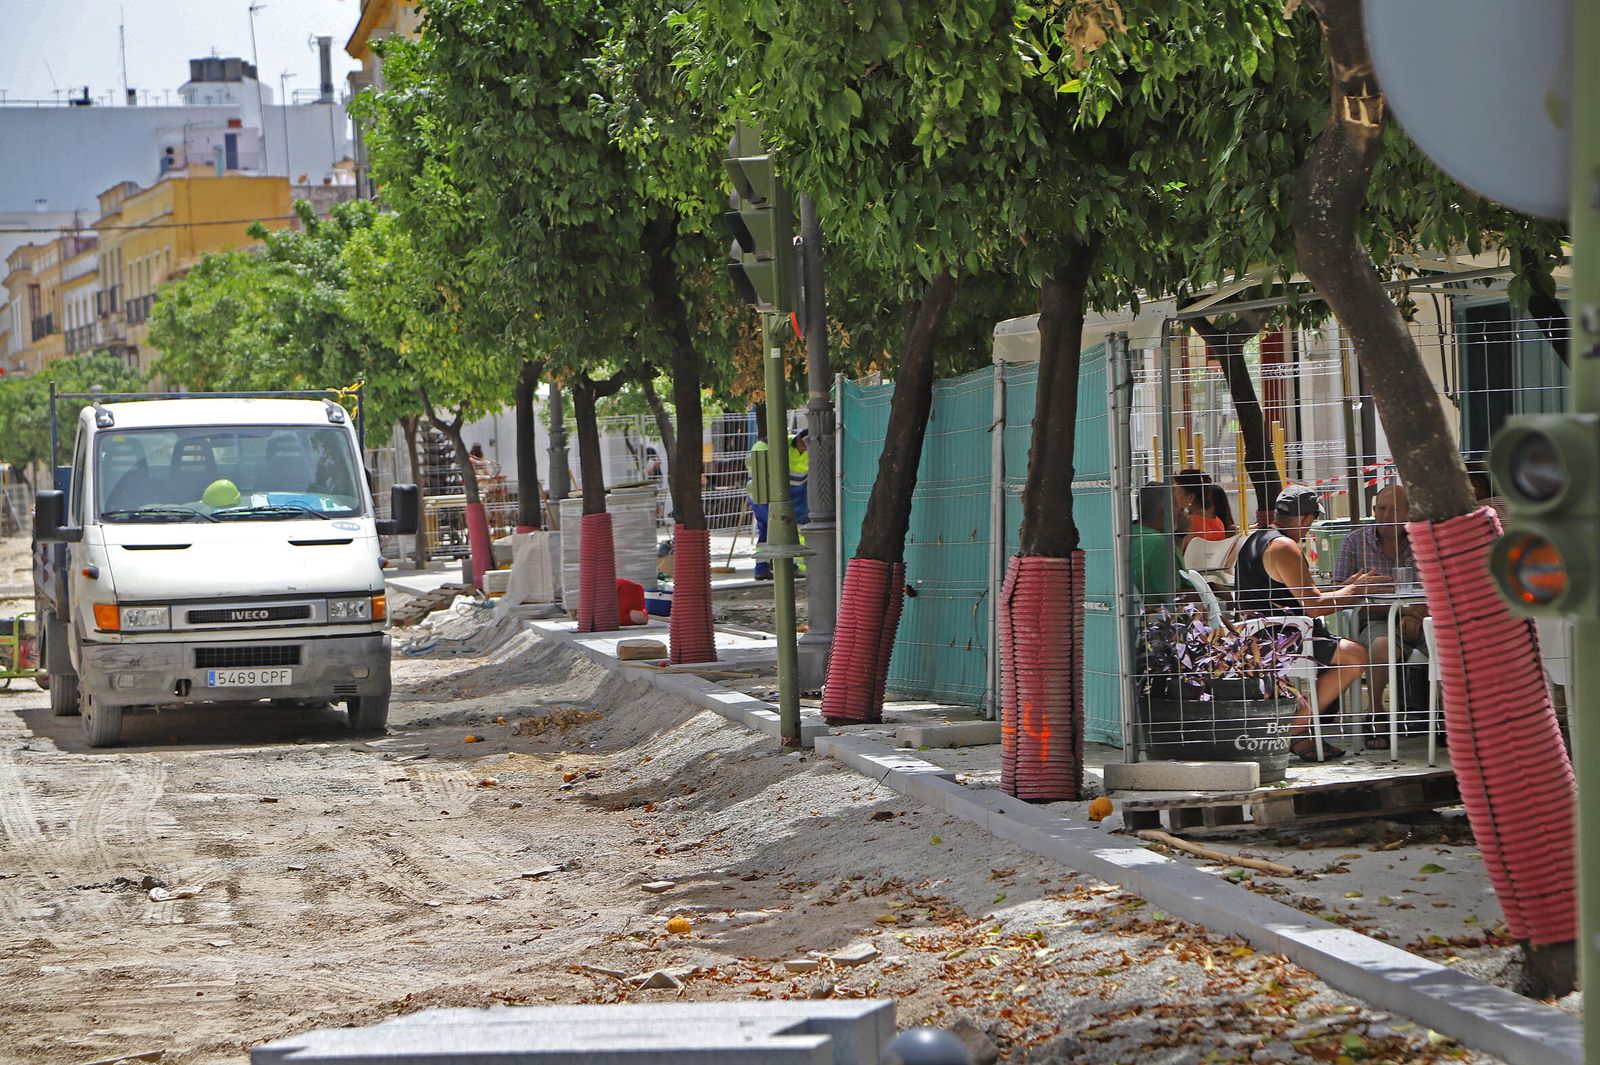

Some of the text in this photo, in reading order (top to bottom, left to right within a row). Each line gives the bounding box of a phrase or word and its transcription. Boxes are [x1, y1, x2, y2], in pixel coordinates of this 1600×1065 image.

[231, 610, 269, 620] IVECO
[218, 671, 288, 685] 5469 CPF
